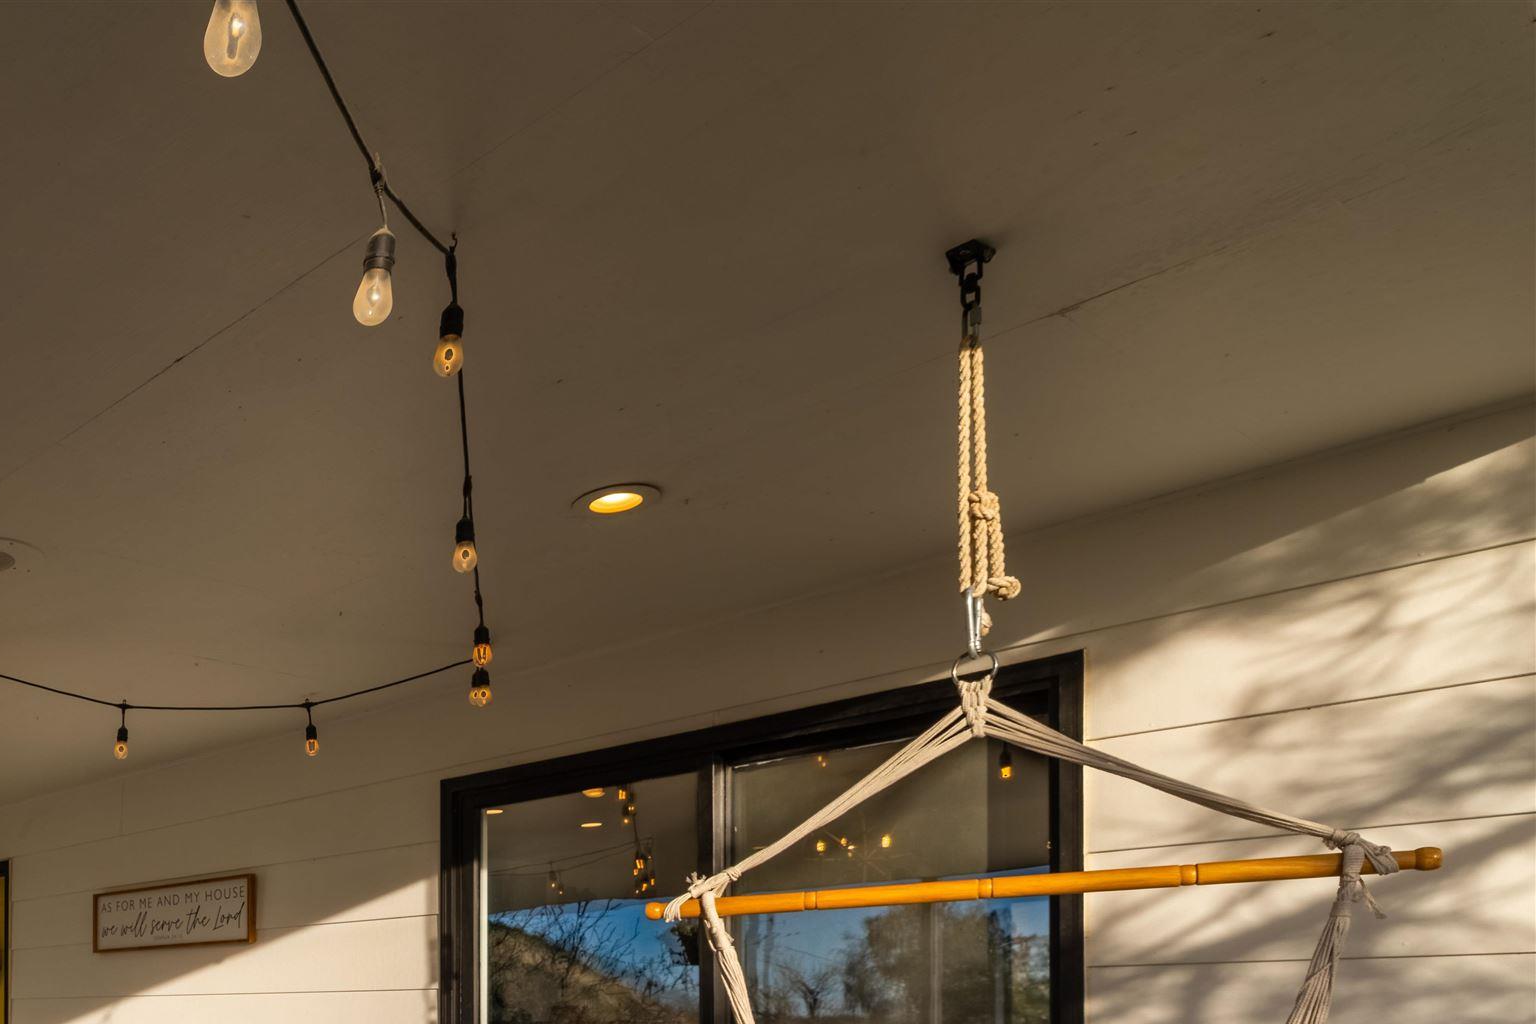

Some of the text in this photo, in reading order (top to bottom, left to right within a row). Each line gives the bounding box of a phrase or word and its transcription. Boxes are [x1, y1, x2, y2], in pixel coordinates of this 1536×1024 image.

[101, 885, 245, 913] AS FOR ME AND MY HOUSE
[101, 902, 245, 938] we will serve the Lord
